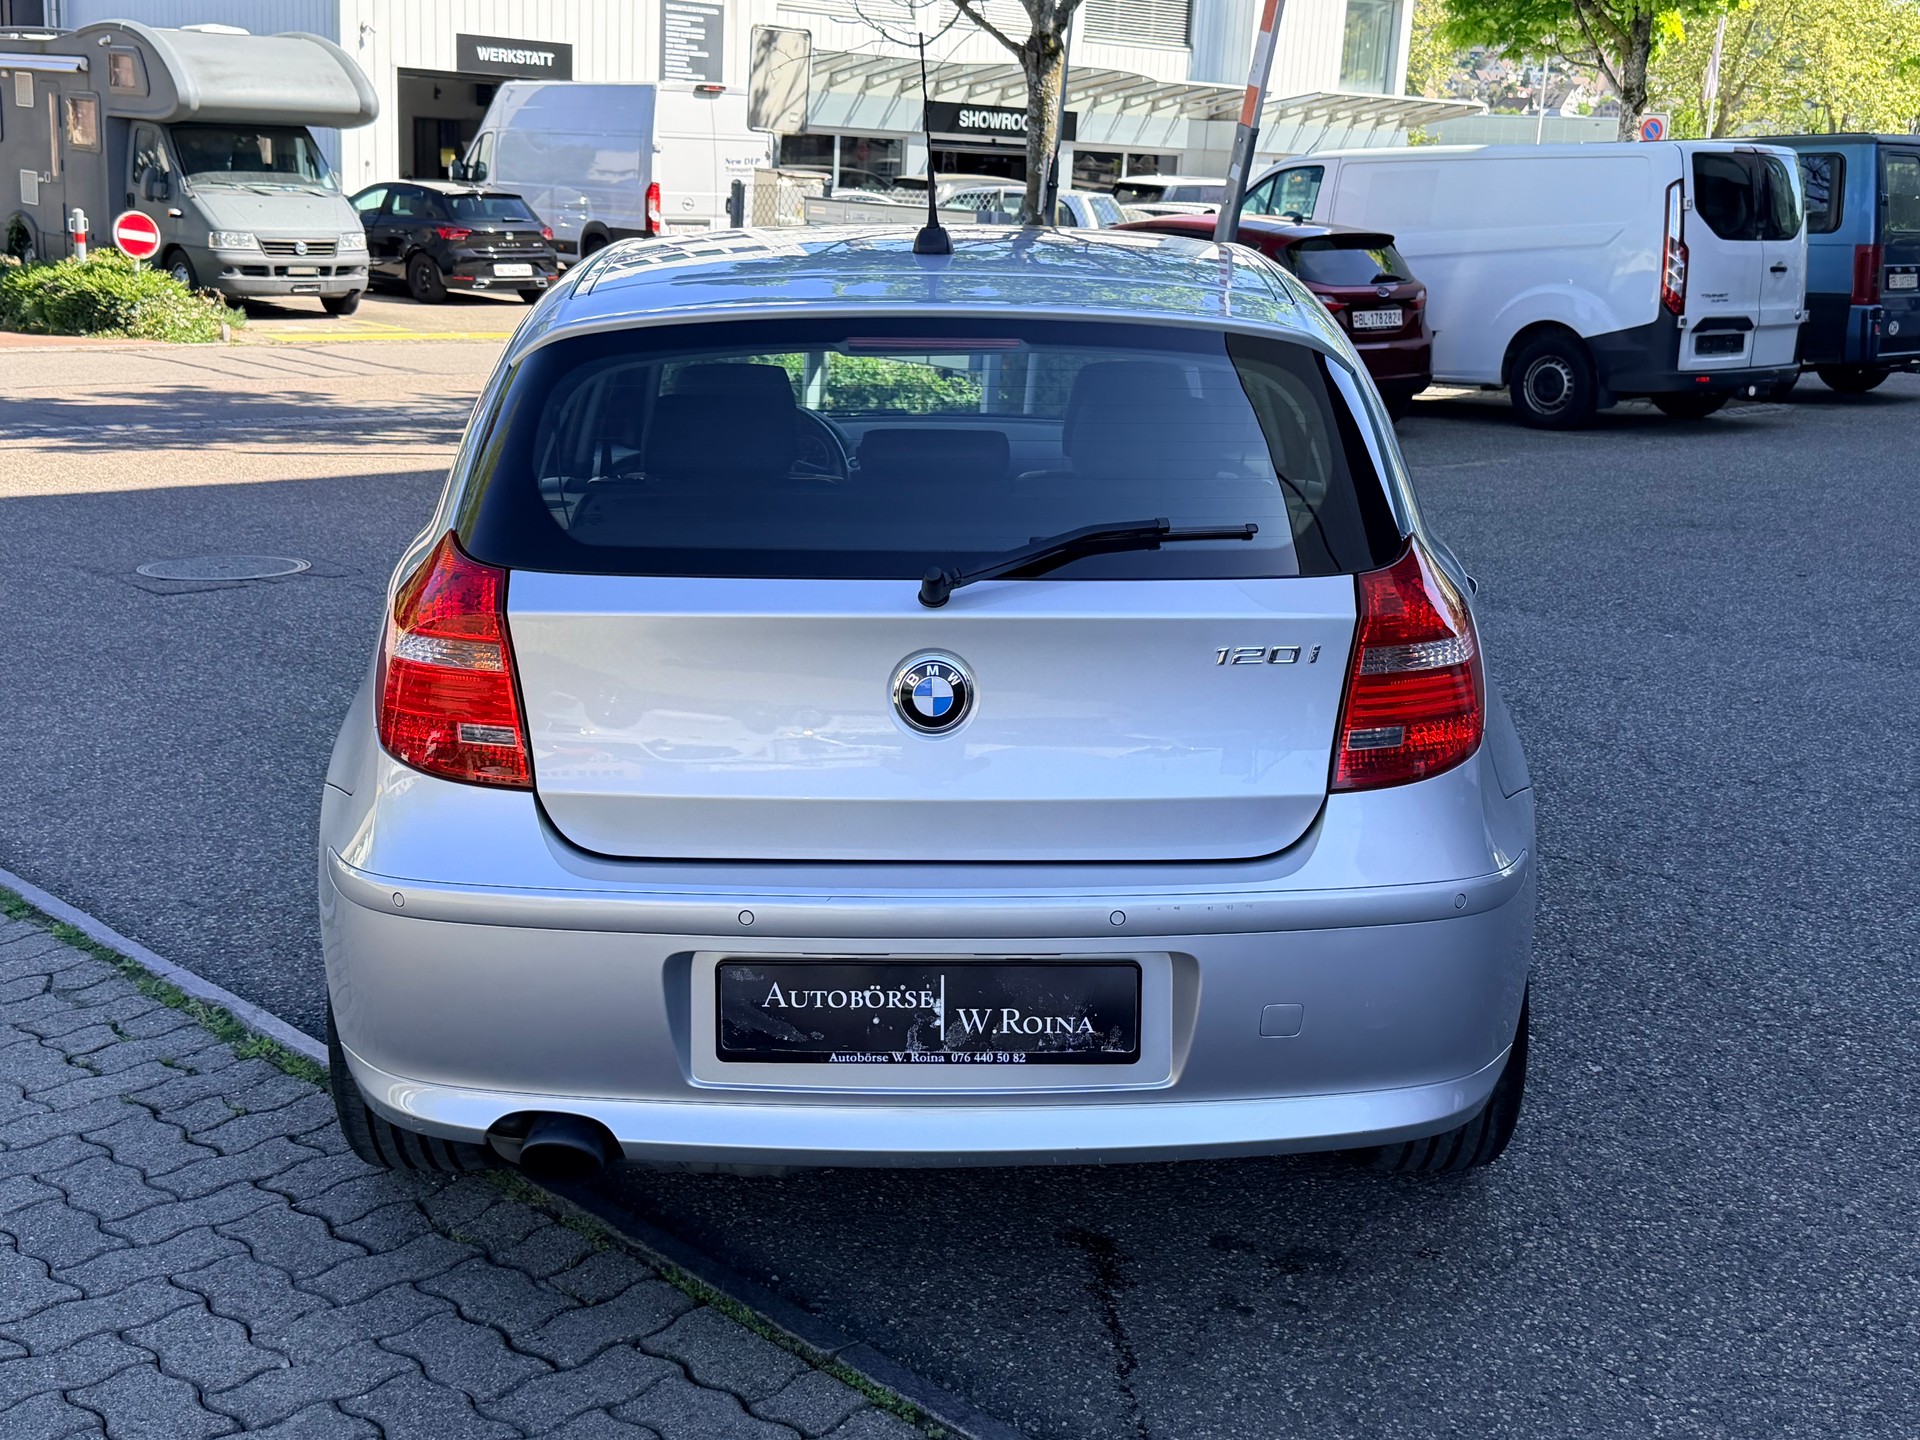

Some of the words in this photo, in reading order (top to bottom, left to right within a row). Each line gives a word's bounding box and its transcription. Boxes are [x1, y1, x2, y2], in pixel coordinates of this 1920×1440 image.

[476, 45, 555, 67] WERKSTATT
[959, 109, 1029, 131] SHOWROO
[1215, 643, 1322, 666] 120i
[905, 664, 962, 687] BMW
[828, 1052, 889, 1063] Autobörse
[892, 1053, 907, 1063] W.
[910, 1052, 945, 1063] Roina
[951, 1053, 971, 1063] 076
[973, 1053, 993, 1063] 440
[996, 1053, 1010, 1063] 50
[1012, 1053, 1026, 1063] 82
